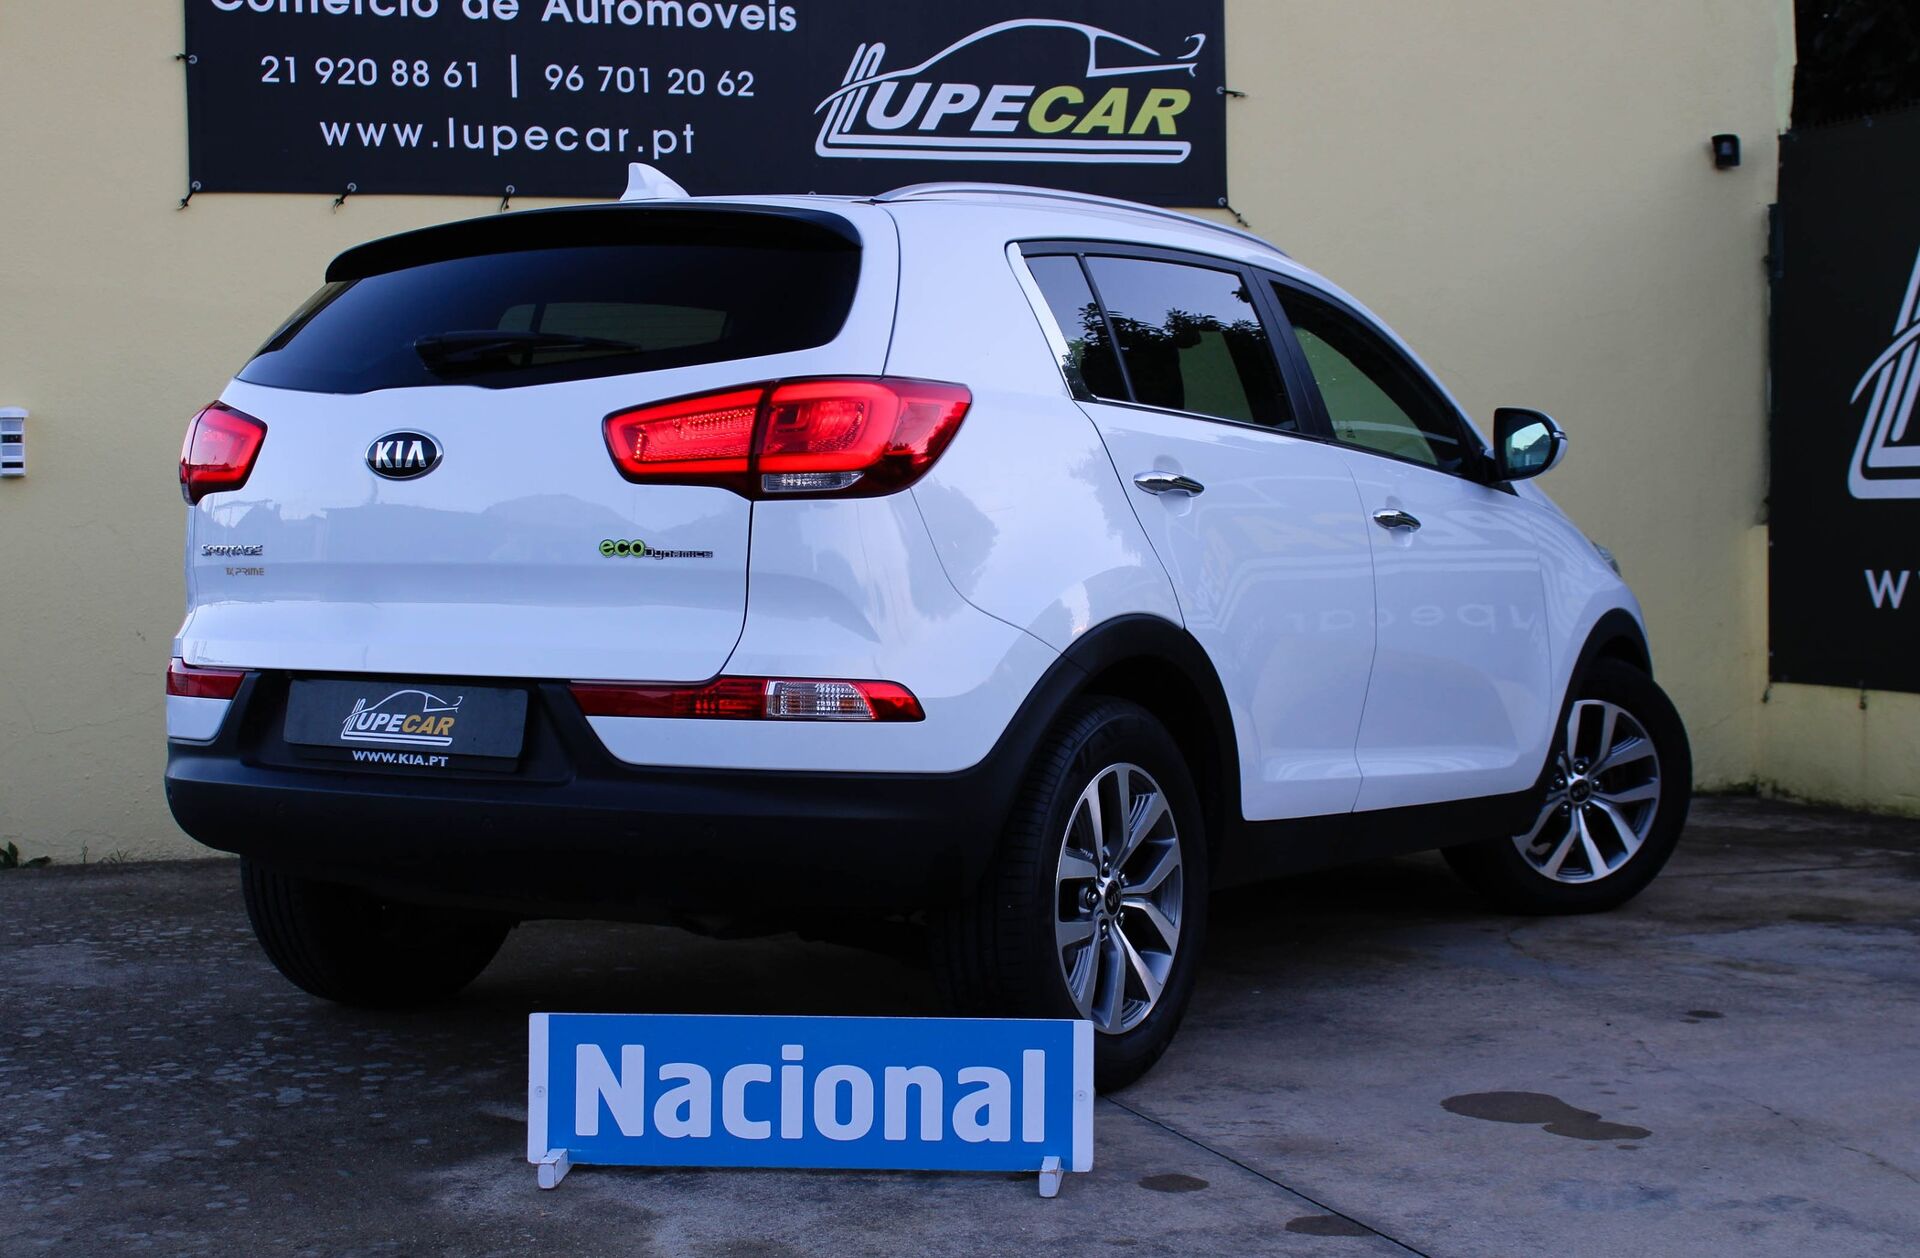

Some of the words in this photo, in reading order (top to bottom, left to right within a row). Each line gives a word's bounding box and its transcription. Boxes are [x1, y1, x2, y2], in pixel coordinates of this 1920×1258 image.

[461, 0, 520, 21] de
[260, 55, 296, 84] 21
[314, 56, 378, 86] 920
[391, 59, 430, 87] 88
[443, 61, 477, 88] 61
[544, 63, 584, 92] 96
[597, 65, 650, 94] 701
[667, 68, 705, 96] 20
[717, 70, 755, 97] 62
[319, 117, 695, 160] www.lupecar.pt
[375, 440, 427, 469] KIA
[351, 750, 449, 767] WWW.KIA.PT
[575, 1043, 1046, 1142] Nacional
